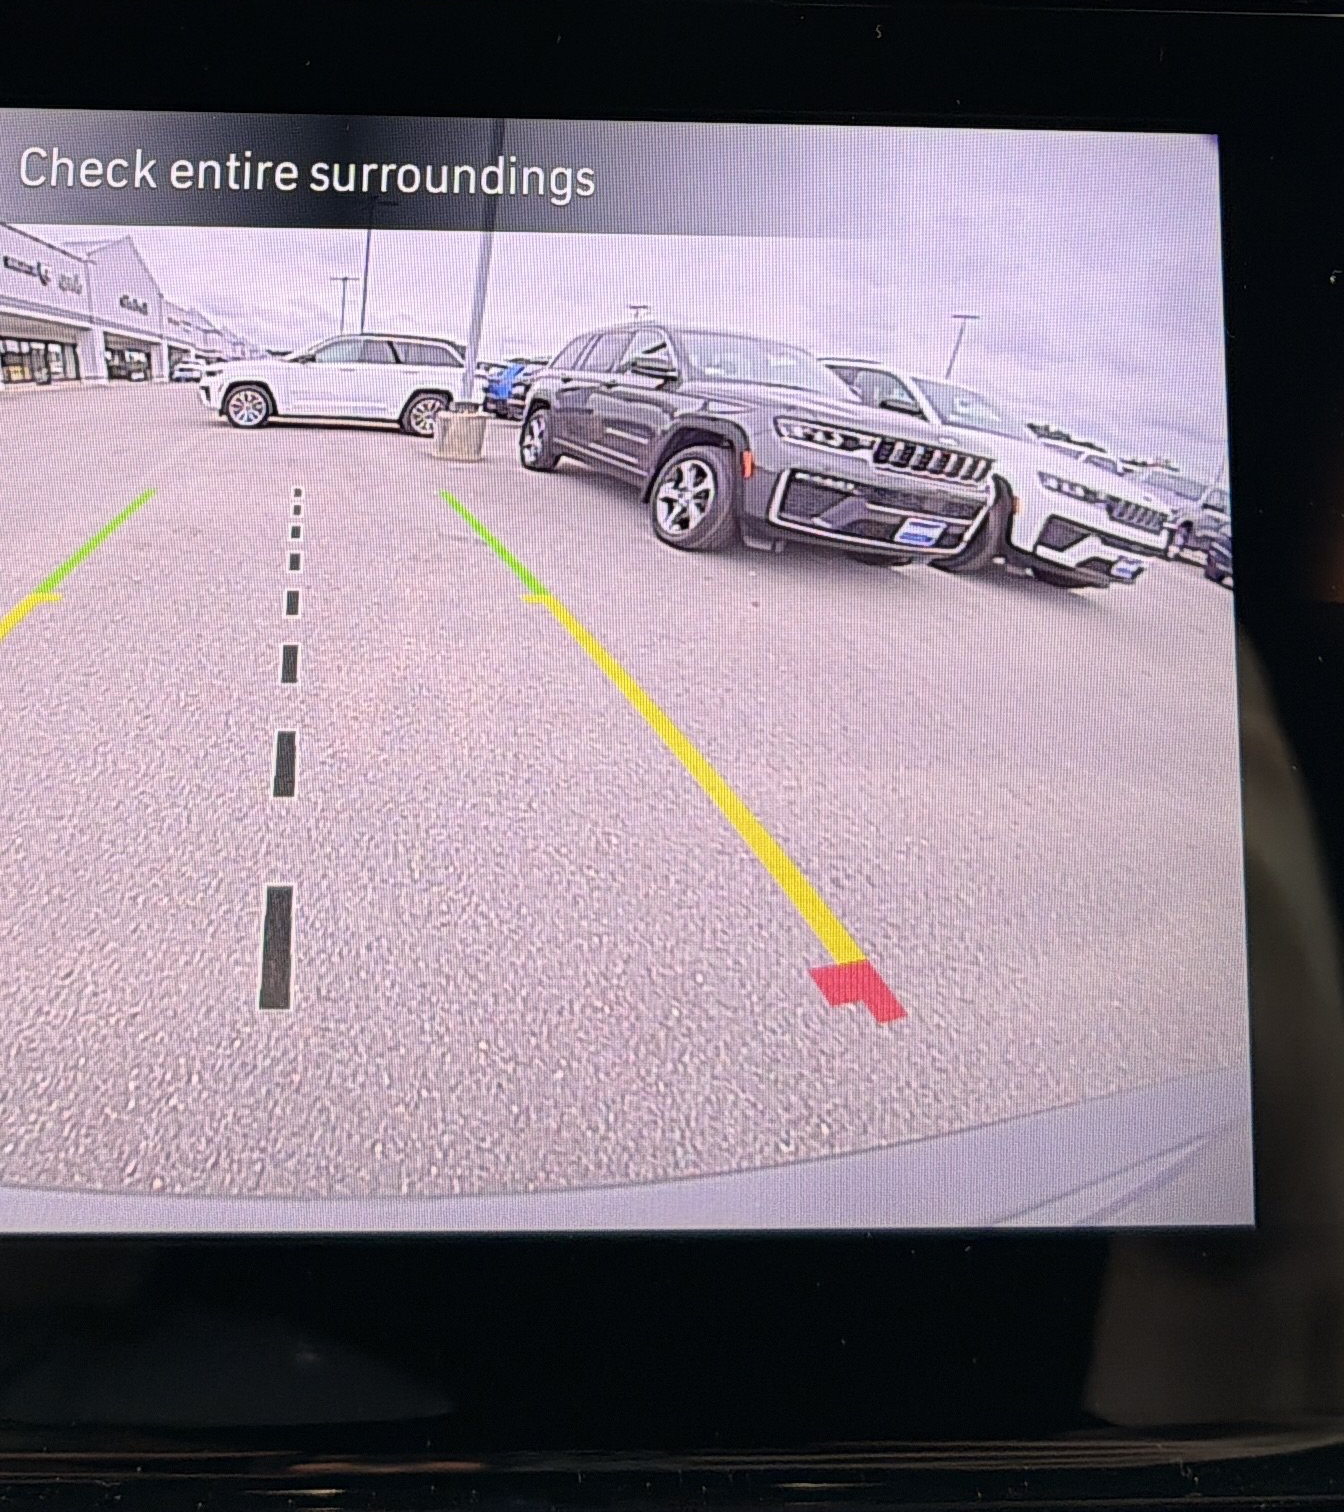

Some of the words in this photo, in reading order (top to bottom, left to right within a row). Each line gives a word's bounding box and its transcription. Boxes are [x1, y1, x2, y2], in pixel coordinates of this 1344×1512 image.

[18, 146, 157, 189] Check
[169, 150, 298, 192] entire
[309, 155, 596, 206] surroundings
